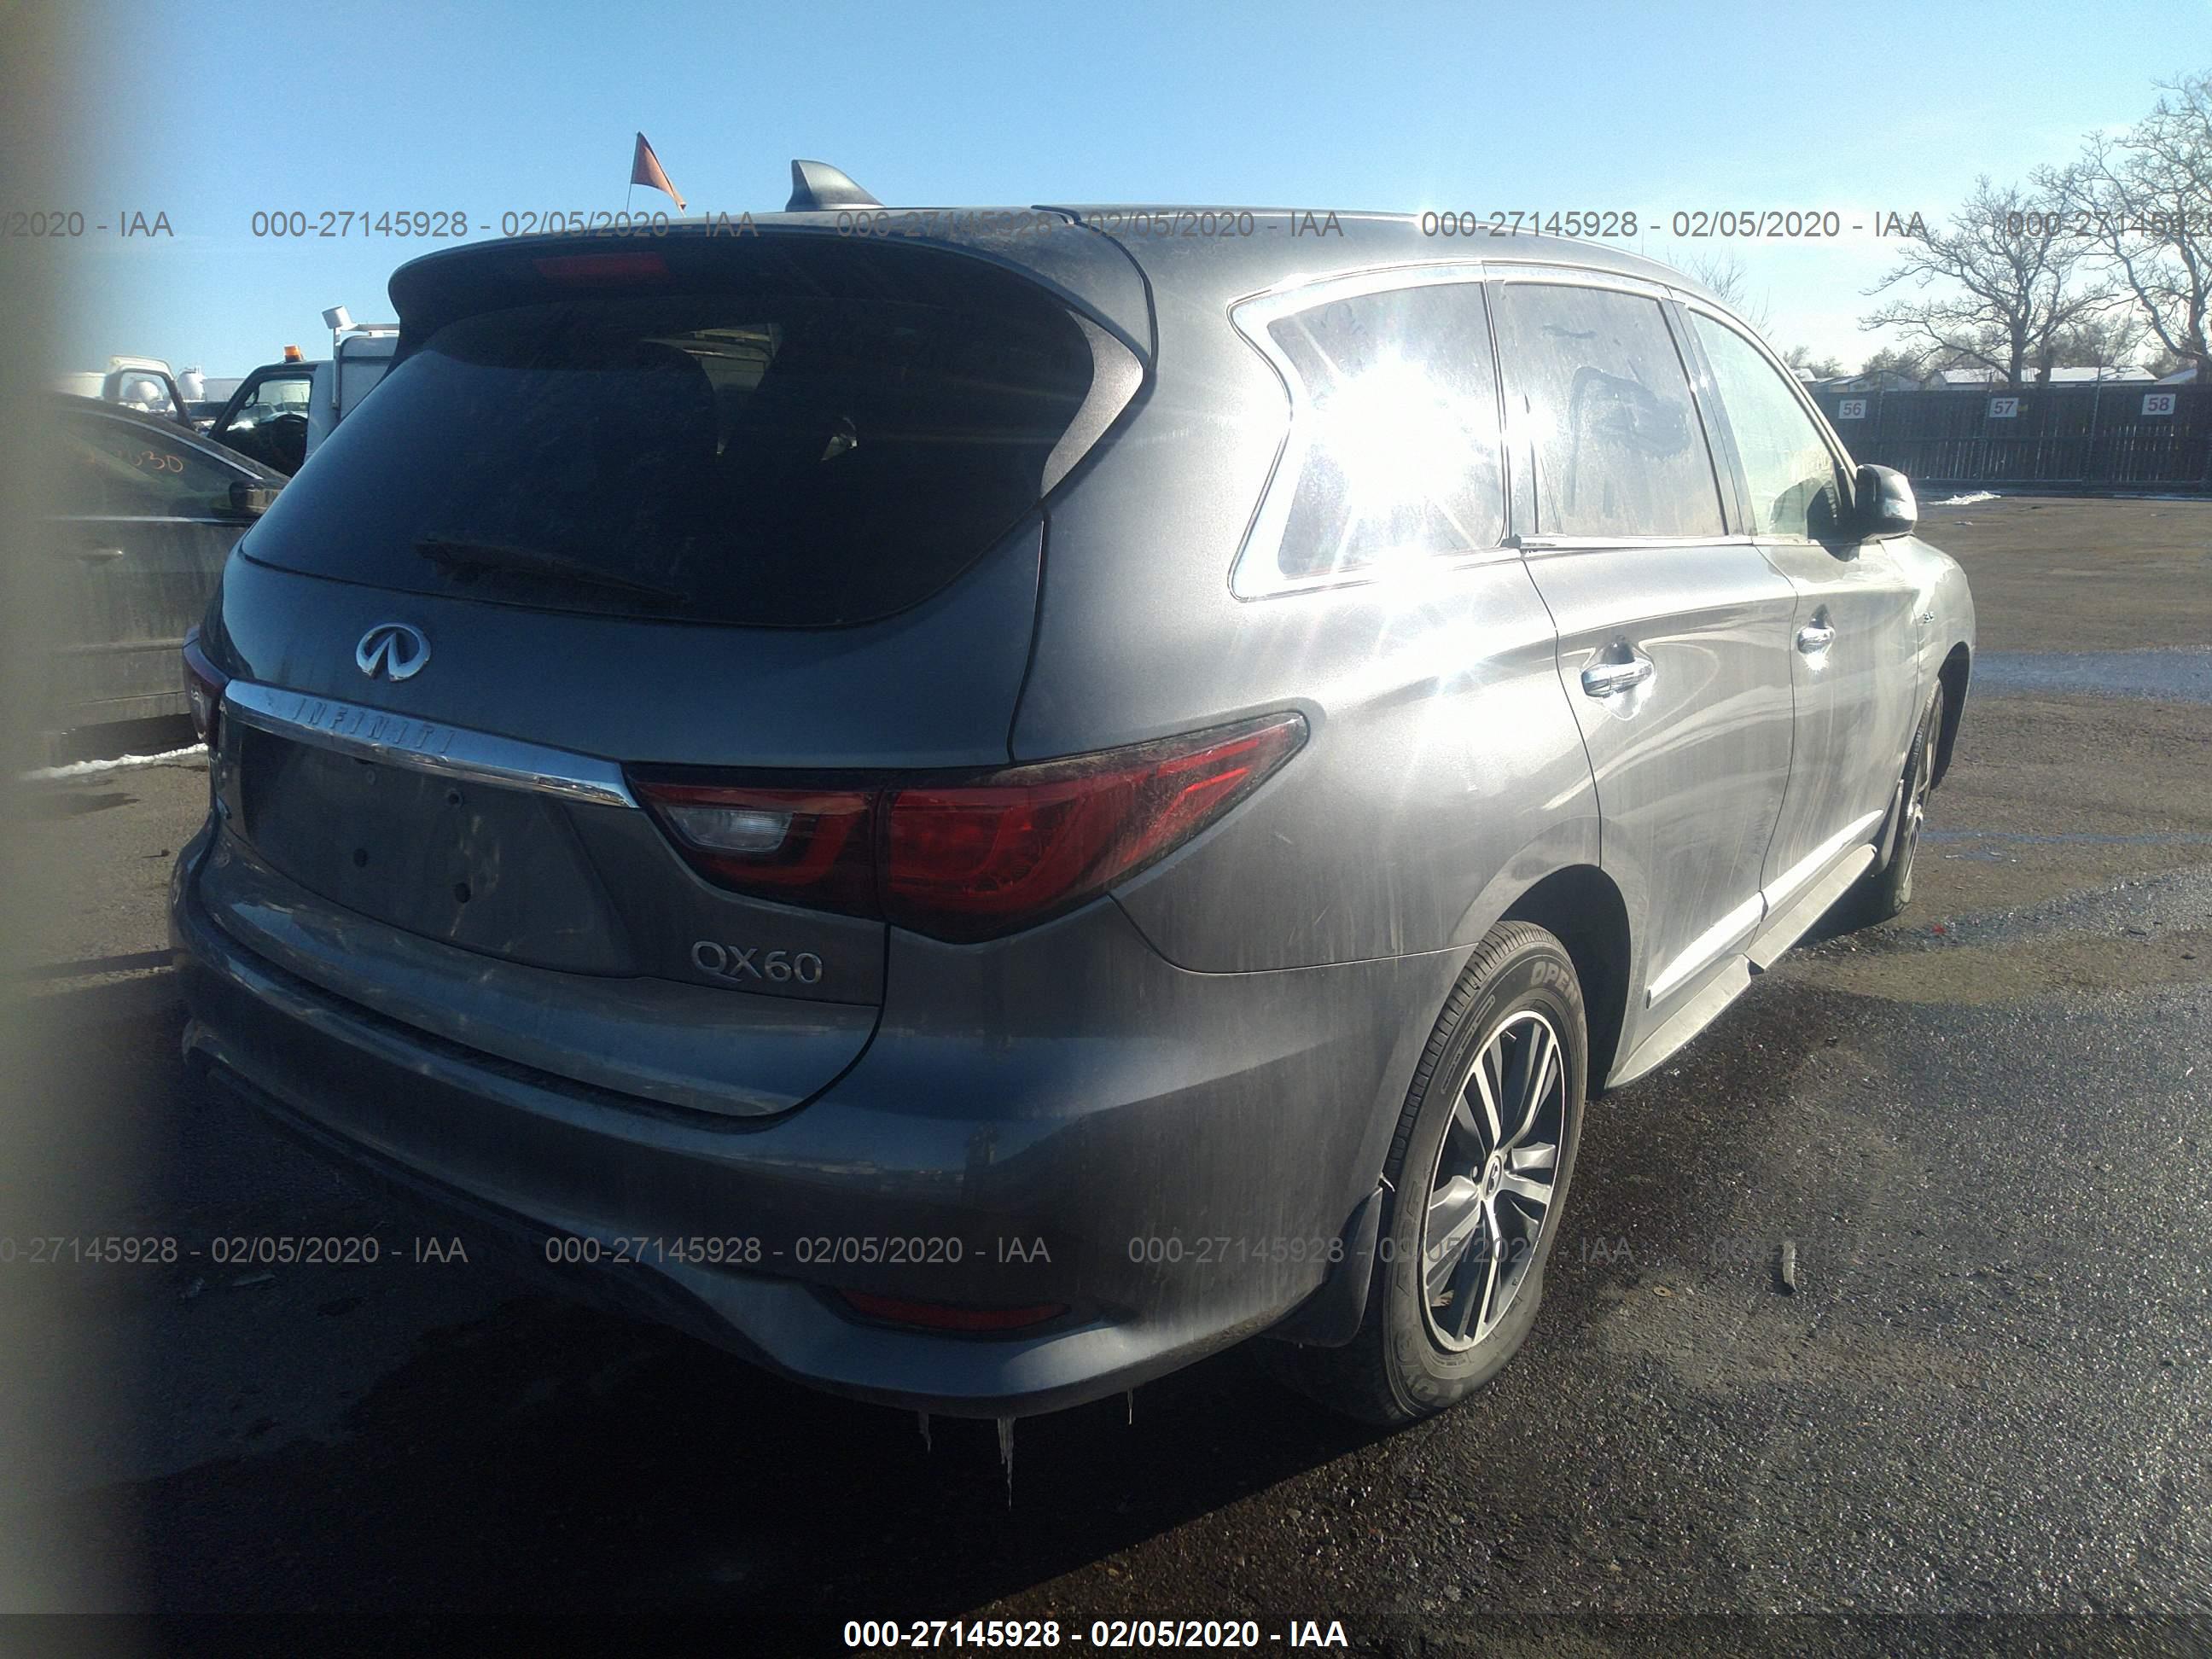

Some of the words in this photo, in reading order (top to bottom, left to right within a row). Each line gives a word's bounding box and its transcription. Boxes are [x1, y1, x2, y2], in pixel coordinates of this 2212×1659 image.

[1842, 402, 1862, 416] 56
[1993, 400, 2015, 415] 57
[2147, 396, 2170, 411] 58
[292, 697, 456, 754] INFINITI
[690, 940, 824, 984] QX60
